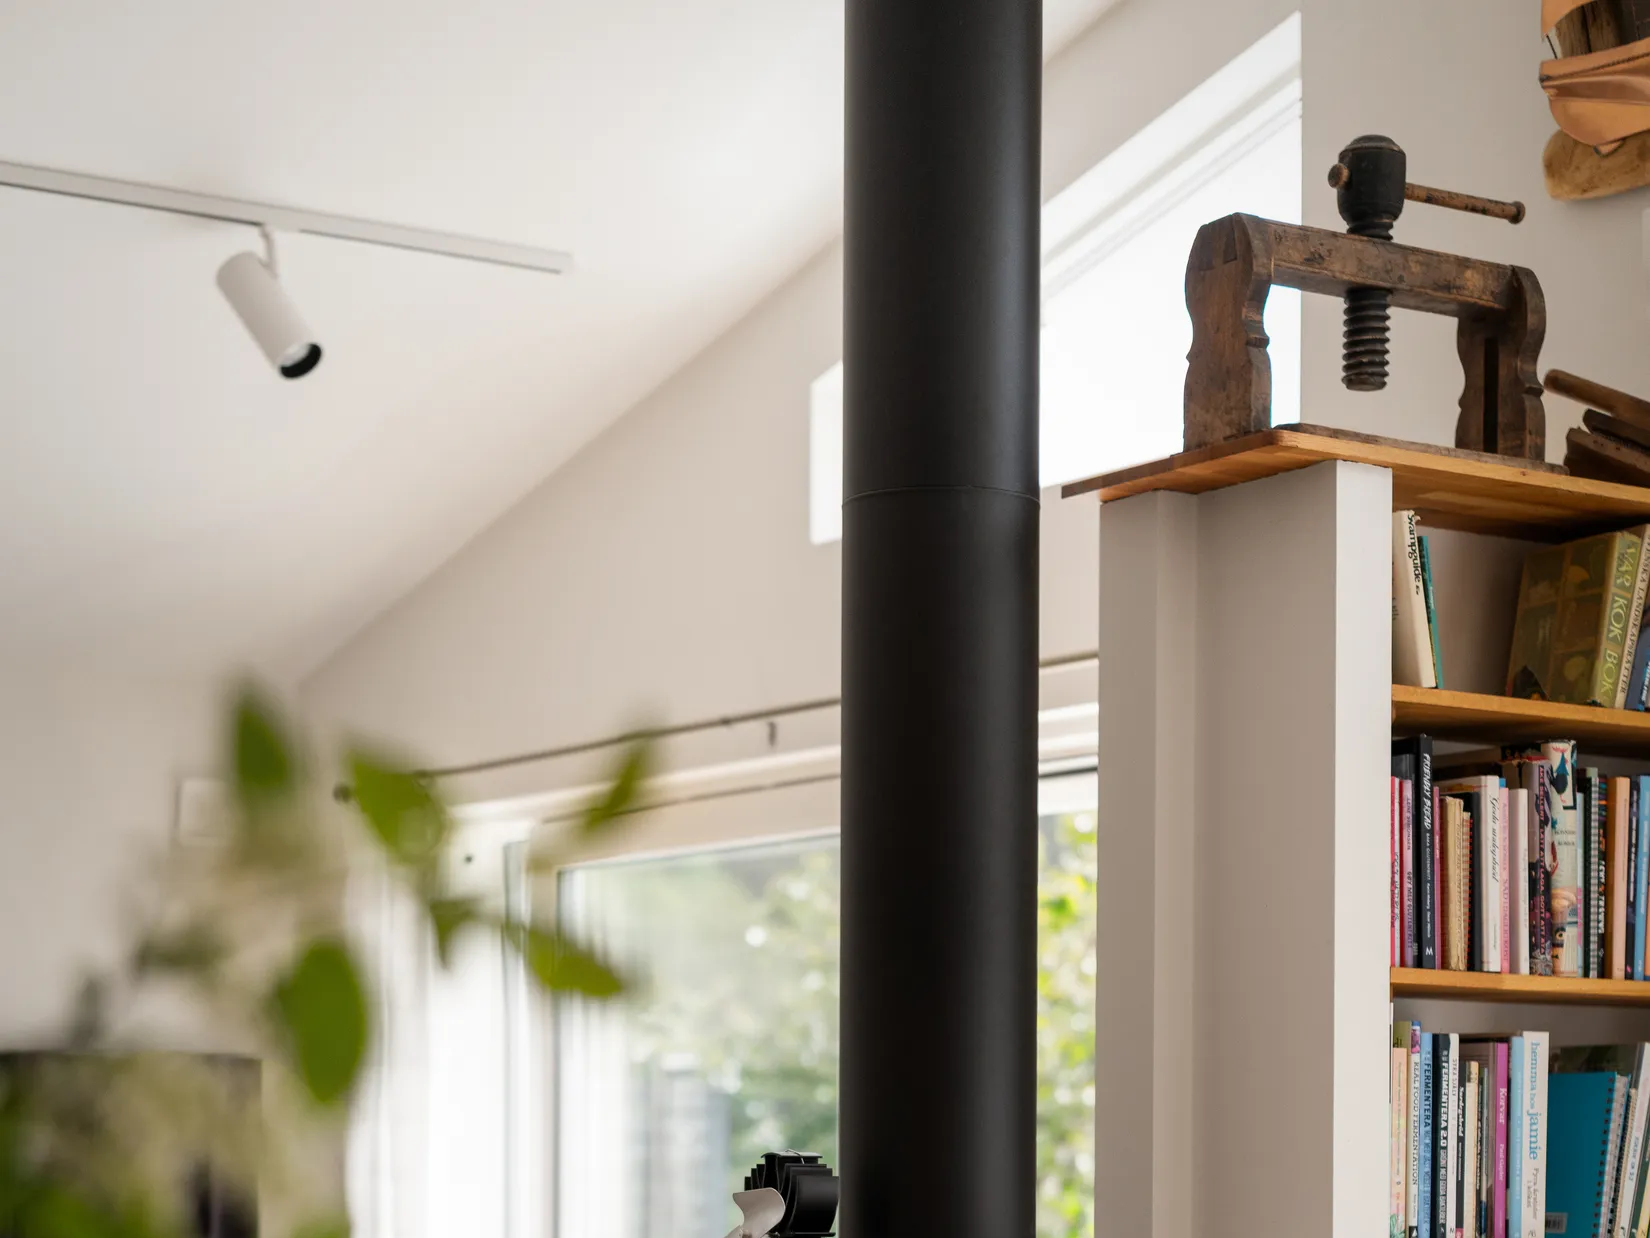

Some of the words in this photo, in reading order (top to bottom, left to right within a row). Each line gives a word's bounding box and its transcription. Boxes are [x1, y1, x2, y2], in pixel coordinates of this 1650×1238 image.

[1407, 514, 1422, 582] Svampguide
[1608, 595, 1627, 642] KOK
[1601, 649, 1619, 697] BOK
[1422, 753, 1431, 798] FRIENDLY
[1423, 797, 1431, 830] BREAD
[1530, 1042, 1540, 1091] hemma
[1423, 1063, 1431, 1128] FERMENTERA
[1499, 1087, 1507, 1125] Korvar
[1526, 1110, 1542, 1160] jamie
